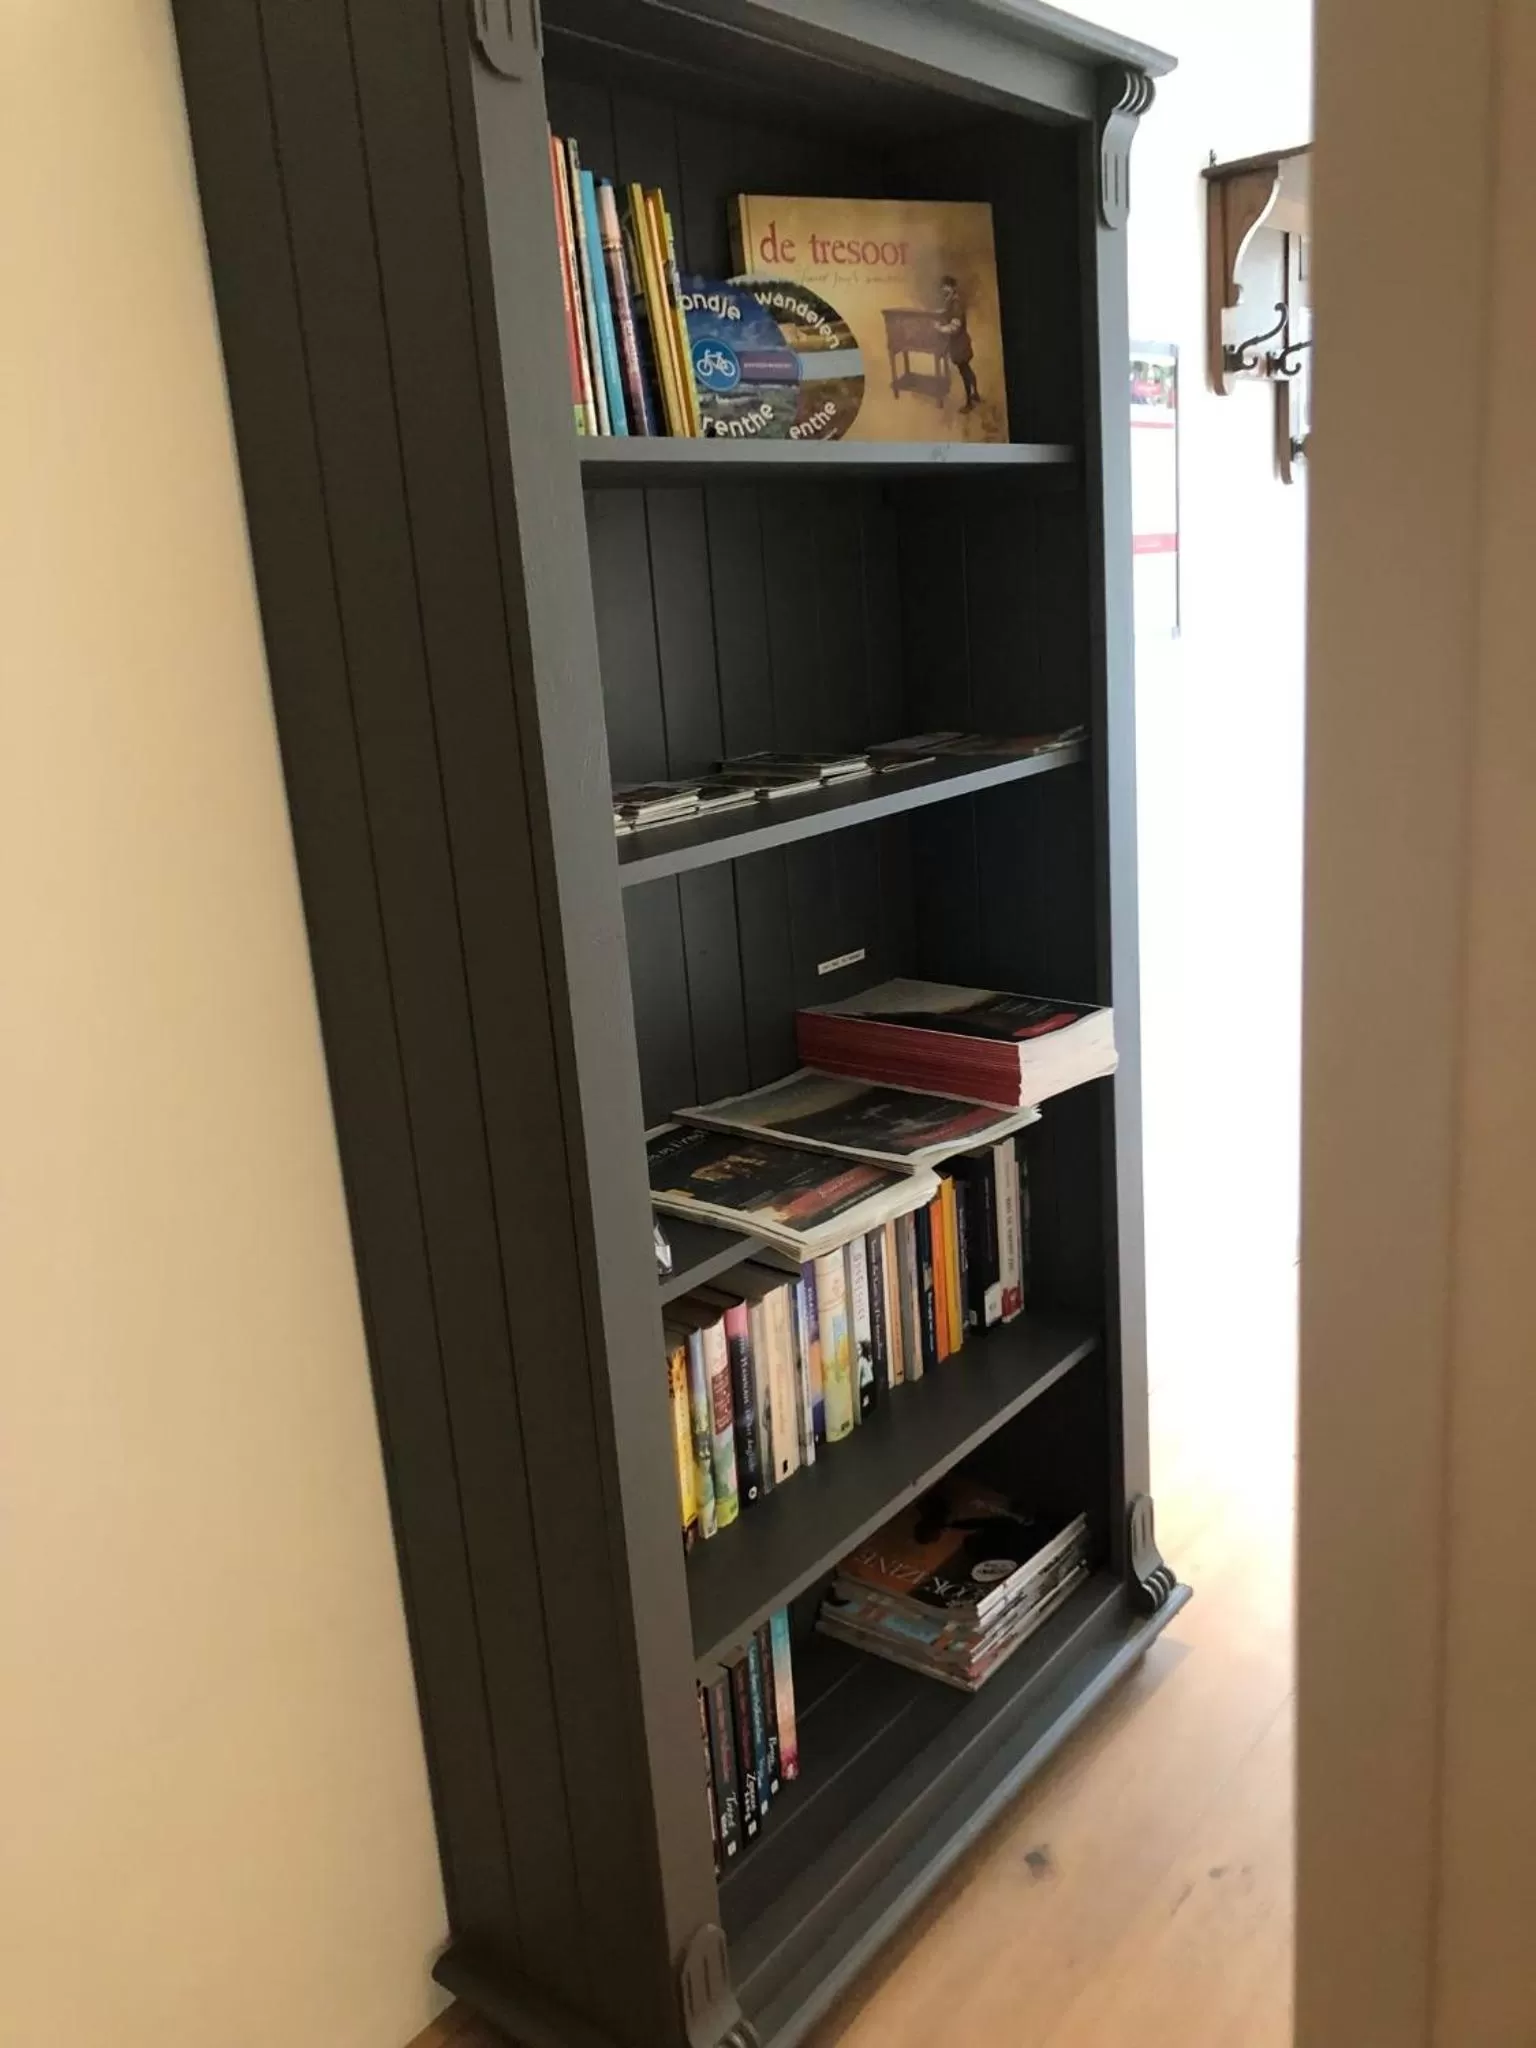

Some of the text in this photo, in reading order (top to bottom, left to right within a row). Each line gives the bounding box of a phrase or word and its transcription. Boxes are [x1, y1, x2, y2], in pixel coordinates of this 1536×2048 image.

[760, 220, 909, 265] de tresoor
[680, 293, 741, 320] ondje
[754, 291, 840, 349] wandelen
[701, 403, 774, 437] renthe
[788, 401, 837, 439] enthe
